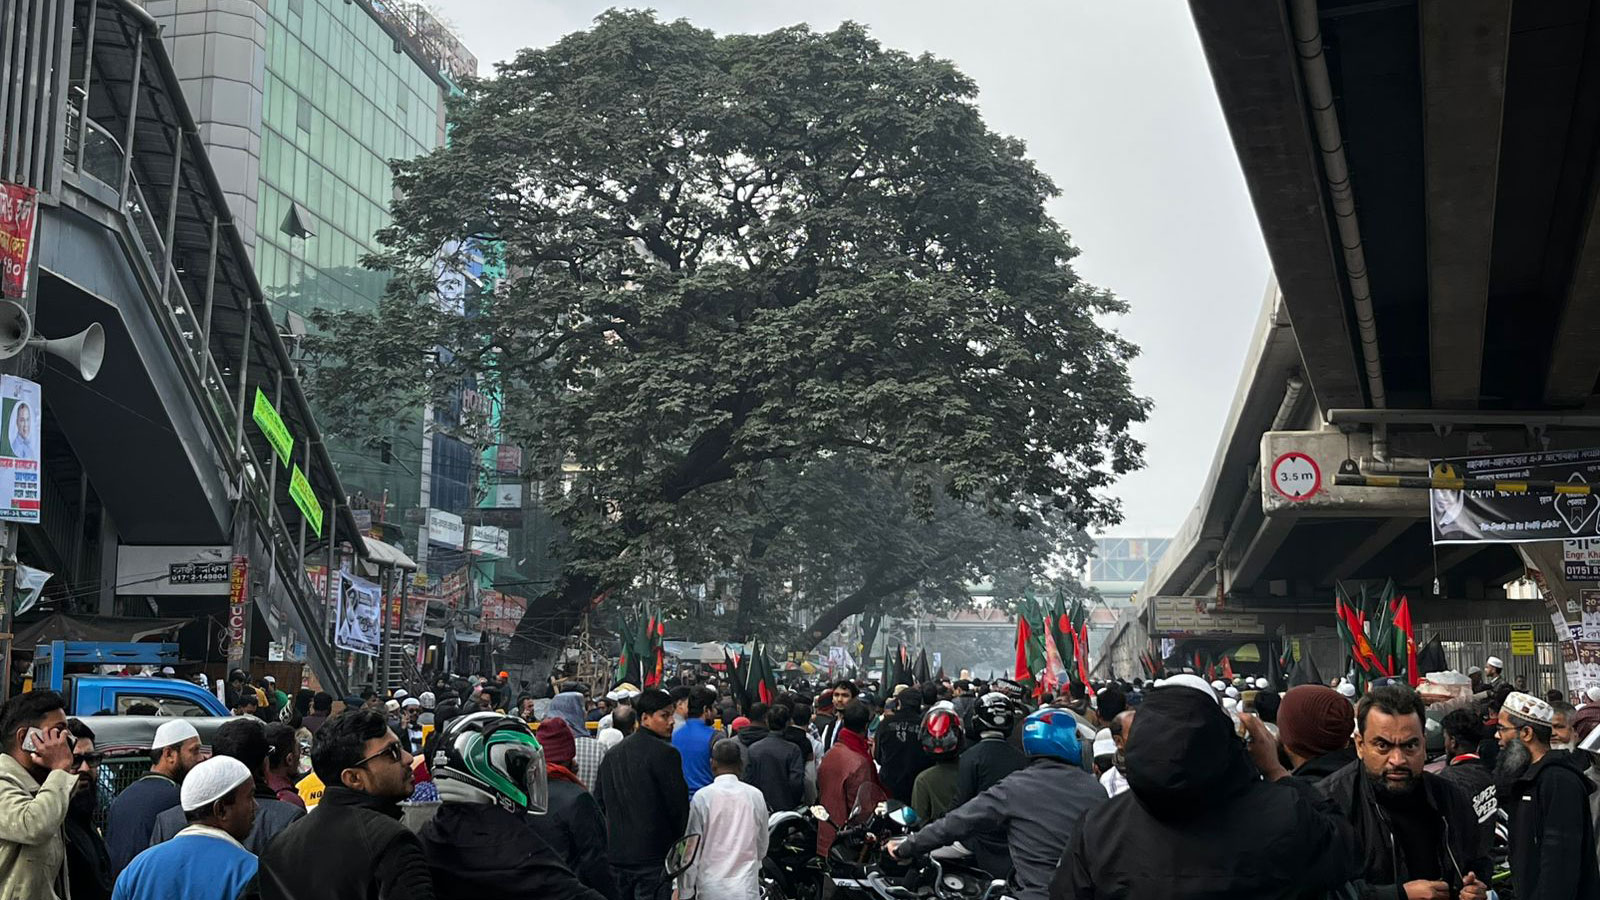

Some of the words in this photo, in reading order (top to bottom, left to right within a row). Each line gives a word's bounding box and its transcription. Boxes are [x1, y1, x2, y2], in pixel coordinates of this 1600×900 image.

[1280, 472, 1299, 482] 3.5
[1301, 472, 1313, 480] m
[1566, 566, 1591, 575] 01751
